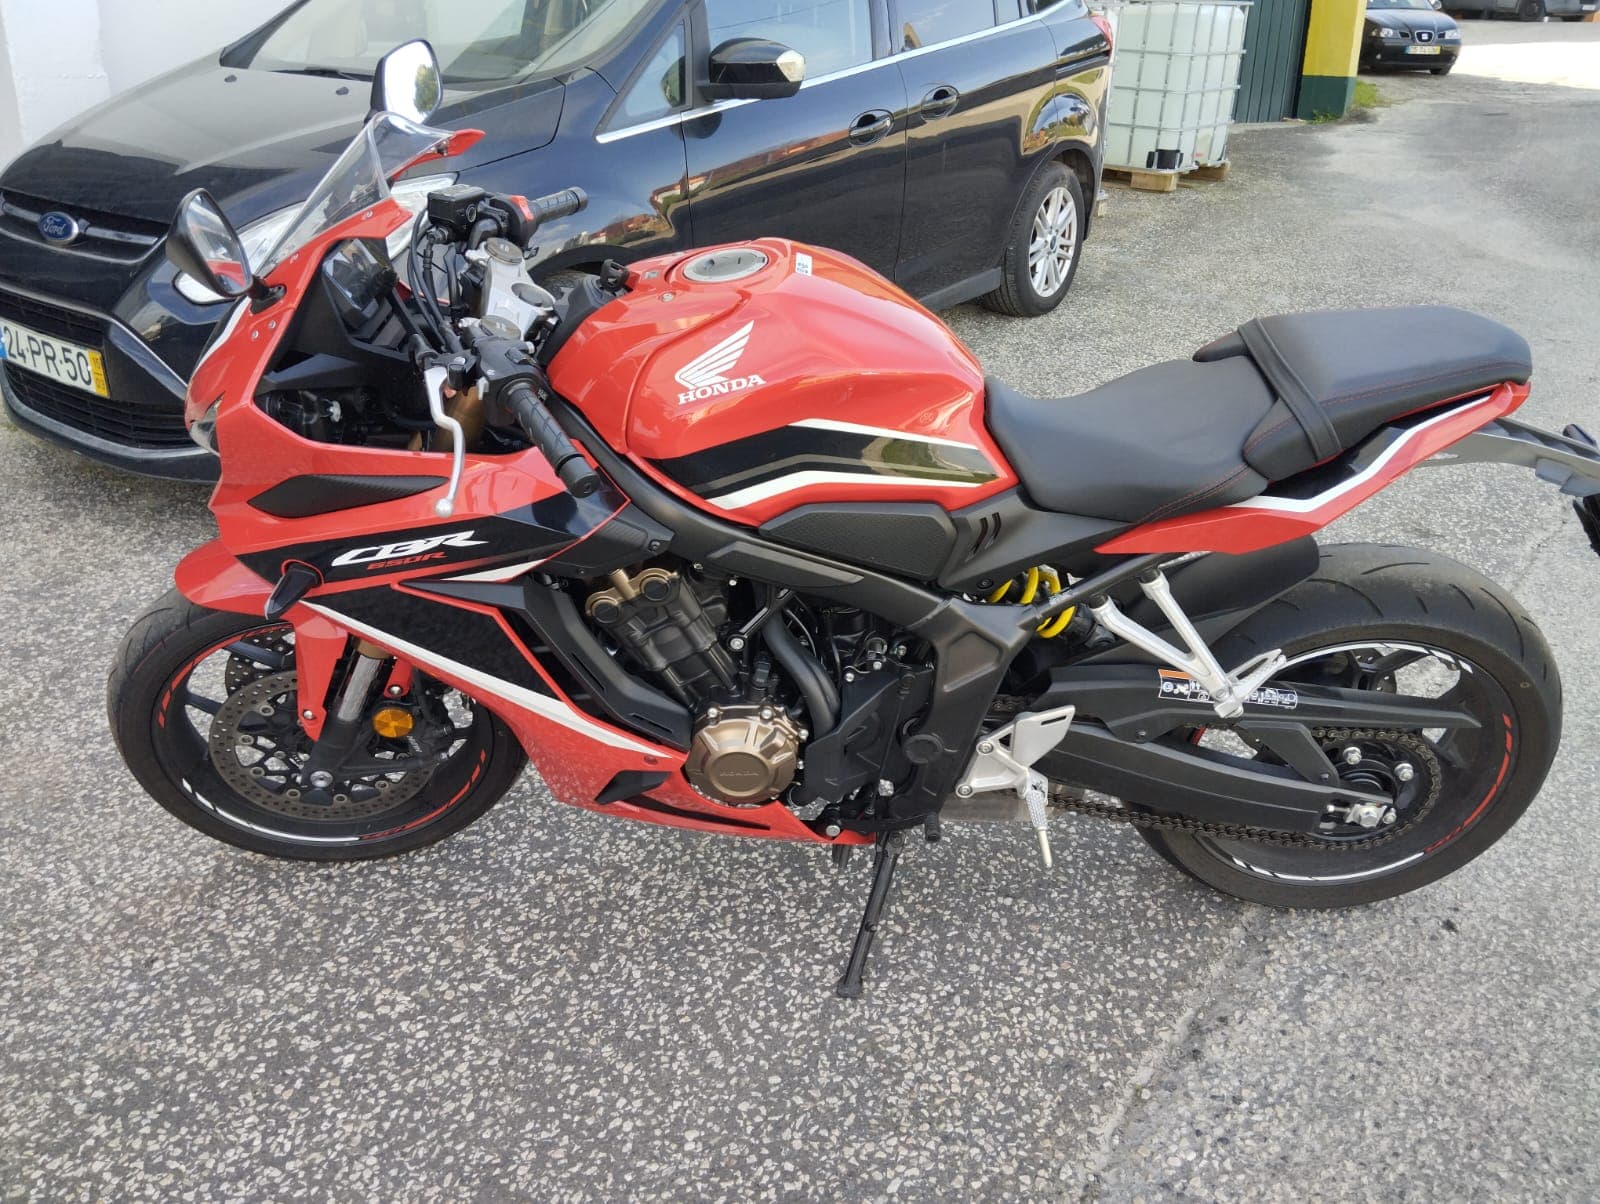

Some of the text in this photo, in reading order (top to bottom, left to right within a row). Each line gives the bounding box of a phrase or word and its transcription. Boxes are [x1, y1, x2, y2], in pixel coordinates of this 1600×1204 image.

[43, 215, 67, 235] Ford
[677, 374, 767, 405] HONDA
[331, 530, 489, 567] CBR
[367, 551, 448, 570] 650R
